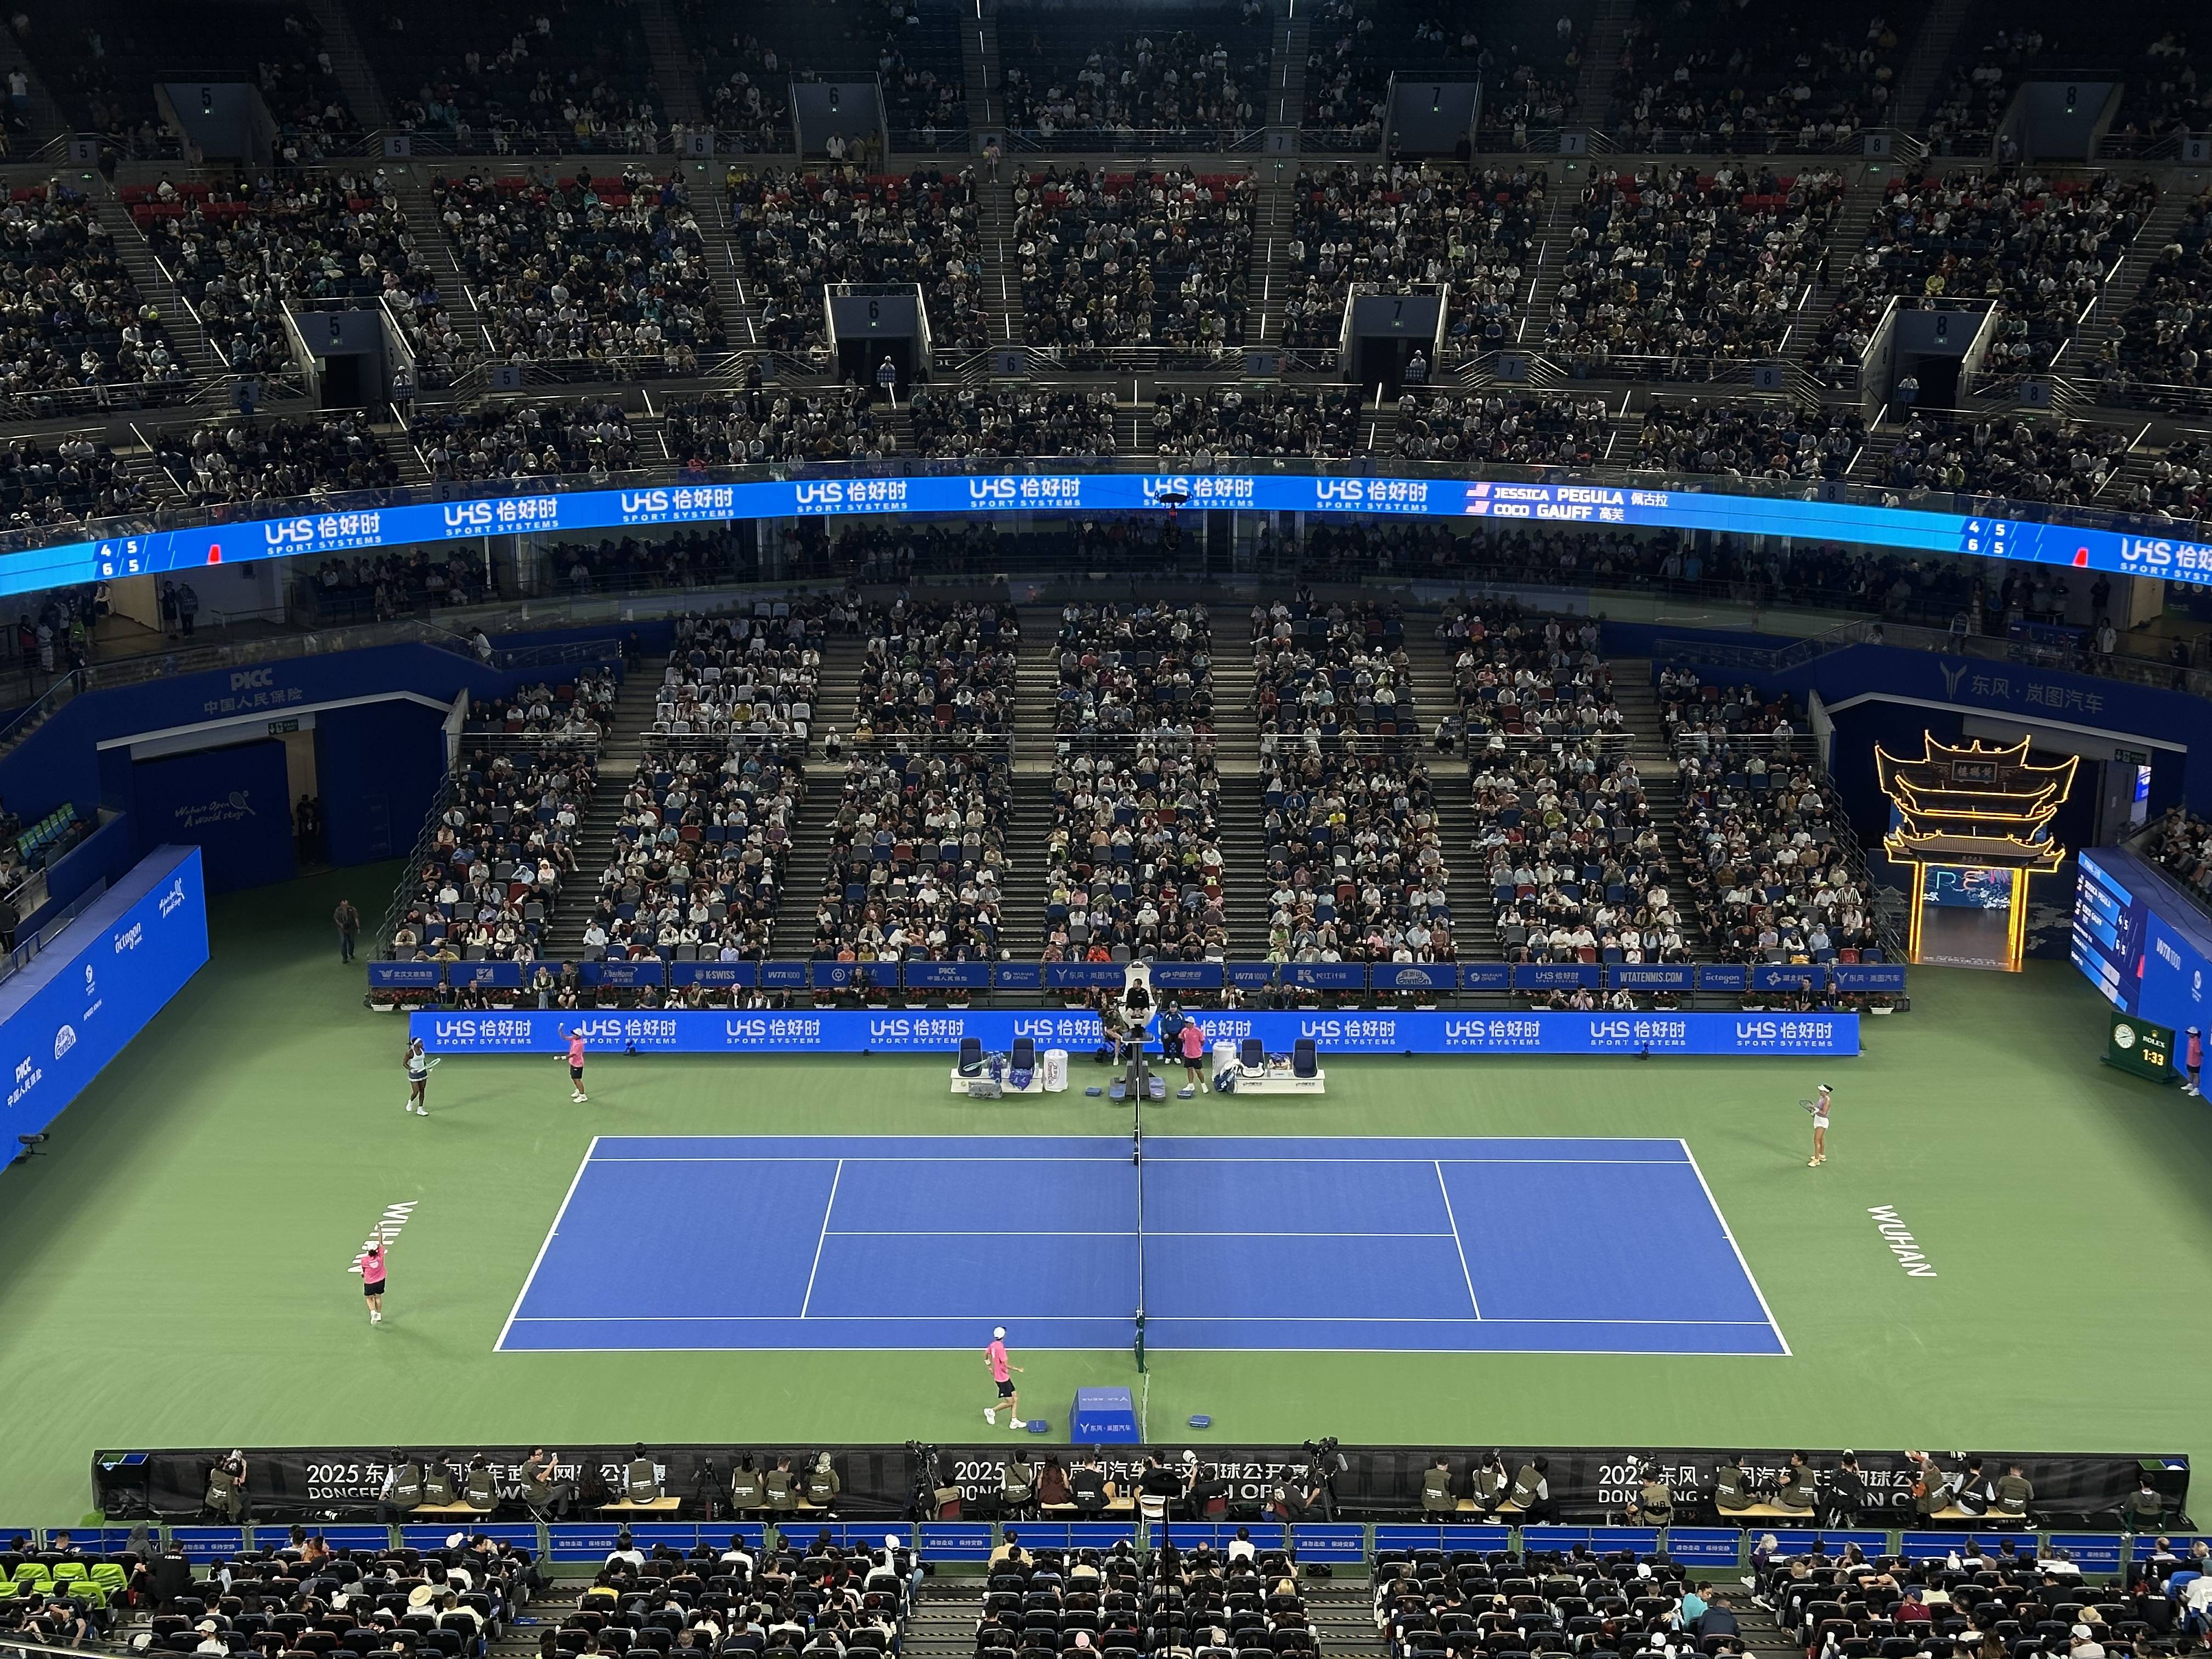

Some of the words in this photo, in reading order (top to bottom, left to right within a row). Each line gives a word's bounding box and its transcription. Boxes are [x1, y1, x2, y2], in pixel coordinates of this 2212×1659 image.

[201, 87, 212, 106] 5
[829, 87, 839, 105] 6
[1432, 87, 1441, 104] 7
[2067, 86, 2076, 105] 8
[80, 144, 88, 159] 5
[394, 140, 402, 153] 5
[695, 137, 703, 153] 6
[1277, 137, 1283, 150] 7
[1570, 137, 1576, 150] 7
[1874, 138, 1881, 152] 8
[2192, 143, 2199, 157] 8
[868, 300, 879, 319] 6
[1393, 301, 1403, 318] 7
[330, 316, 340, 336] 5
[1937, 315, 1947, 336] 8
[1007, 356, 1015, 372] 6
[1256, 357, 1262, 370] 7
[1509, 362, 1515, 375] 7
[503, 370, 511, 385] 5
[1764, 370, 1771, 385] 8
[2030, 386, 2038, 401] 8
[796, 481, 843, 504] UHS
[847, 480, 907, 501] 恰好时
[970, 478, 1016, 499] UHS
[1020, 477, 1081, 498] 恰好时
[1143, 477, 1189, 498] UHS
[1193, 477, 1254, 498] 恰好时
[1317, 479, 1363, 500] UHS
[1367, 481, 1428, 502] 恰好时
[622, 490, 668, 512] UHS
[672, 487, 733, 510] 恰好时
[1020, 499, 1080, 508] SYSTEMS
[1493, 487, 1549, 501] JESSICA
[1557, 488, 1624, 505] PEGULA
[1630, 492, 1668, 507] 佩古拉
[444, 500, 493, 526] UHS
[496, 497, 557, 522] 恰好时
[623, 513, 666, 522] SPORT
[673, 509, 734, 519] SYSTEMS
[848, 503, 907, 511] SYSTEMS
[1367, 503, 1427, 511] SYSTEMS
[1493, 504, 1530, 516] COCO
[1537, 504, 1593, 520] GAUFF
[1599, 507, 1624, 521] 高芙
[265, 519, 314, 544] UHS
[317, 512, 380, 539] 恰好时
[446, 526, 491, 536] SPORT
[498, 520, 558, 532] SYSTEMS
[1968, 521, 1979, 533] 4
[1995, 523, 2005, 536] 5
[100, 544, 112, 556] 4
[127, 540, 137, 554] 5
[267, 543, 312, 555] SPORT
[319, 535, 381, 548] SYSTEMS
[1968, 539, 1978, 551] 6
[1994, 541, 2004, 554] 5
[2121, 537, 2171, 565] UHS
[102, 563, 113, 575] 6
[129, 560, 139, 572] 5
[2120, 562, 2168, 576] SPORT
[230, 667, 273, 692] PICC
[204, 686, 303, 715] 中国人民保险
[2123, 919, 2129, 931] 5
[2115, 938, 2120, 950] 6
[2120, 944, 2126, 956] 5
[1536, 972, 1554, 980] UHS
[1620, 972, 1683, 983] WTATENNIS.COM
[1706, 974, 1740, 985] octagon
[436, 1020, 476, 1037] UHS
[479, 1020, 531, 1037] 恰好时
[582, 1019, 622, 1036] UHS
[625, 1019, 676, 1036] 恰好时
[726, 1019, 766, 1036] UHS
[769, 1019, 820, 1036] 恰好时
[871, 1019, 910, 1036] UHS
[913, 1019, 964, 1036] 恰好时
[1014, 1019, 1053, 1036] UHS
[1200, 1020, 1252, 1037] 恰好时
[1302, 1020, 1341, 1037] UHS
[1344, 1020, 1396, 1037] 恰好时
[1446, 1020, 1485, 1037] UHS
[1488, 1020, 1540, 1037] 恰好时
[1590, 1021, 1630, 1037] UHS
[1634, 1021, 1686, 1037] 恰好时
[1737, 1022, 1776, 1039] UHS
[1780, 1022, 1832, 1039] 恰好时
[2142, 1035, 2166, 1048] ROLEX
[2142, 1048, 2164, 1066] 1:33
[15, 1055, 32, 1084] PICC
[1866, 1204, 1938, 1277] WUHAN
[306, 1464, 359, 1483] 2025
[954, 1461, 1005, 1481] 2025
[1598, 1465, 1644, 1485] 202
[308, 1486, 381, 1500] DONGFE
